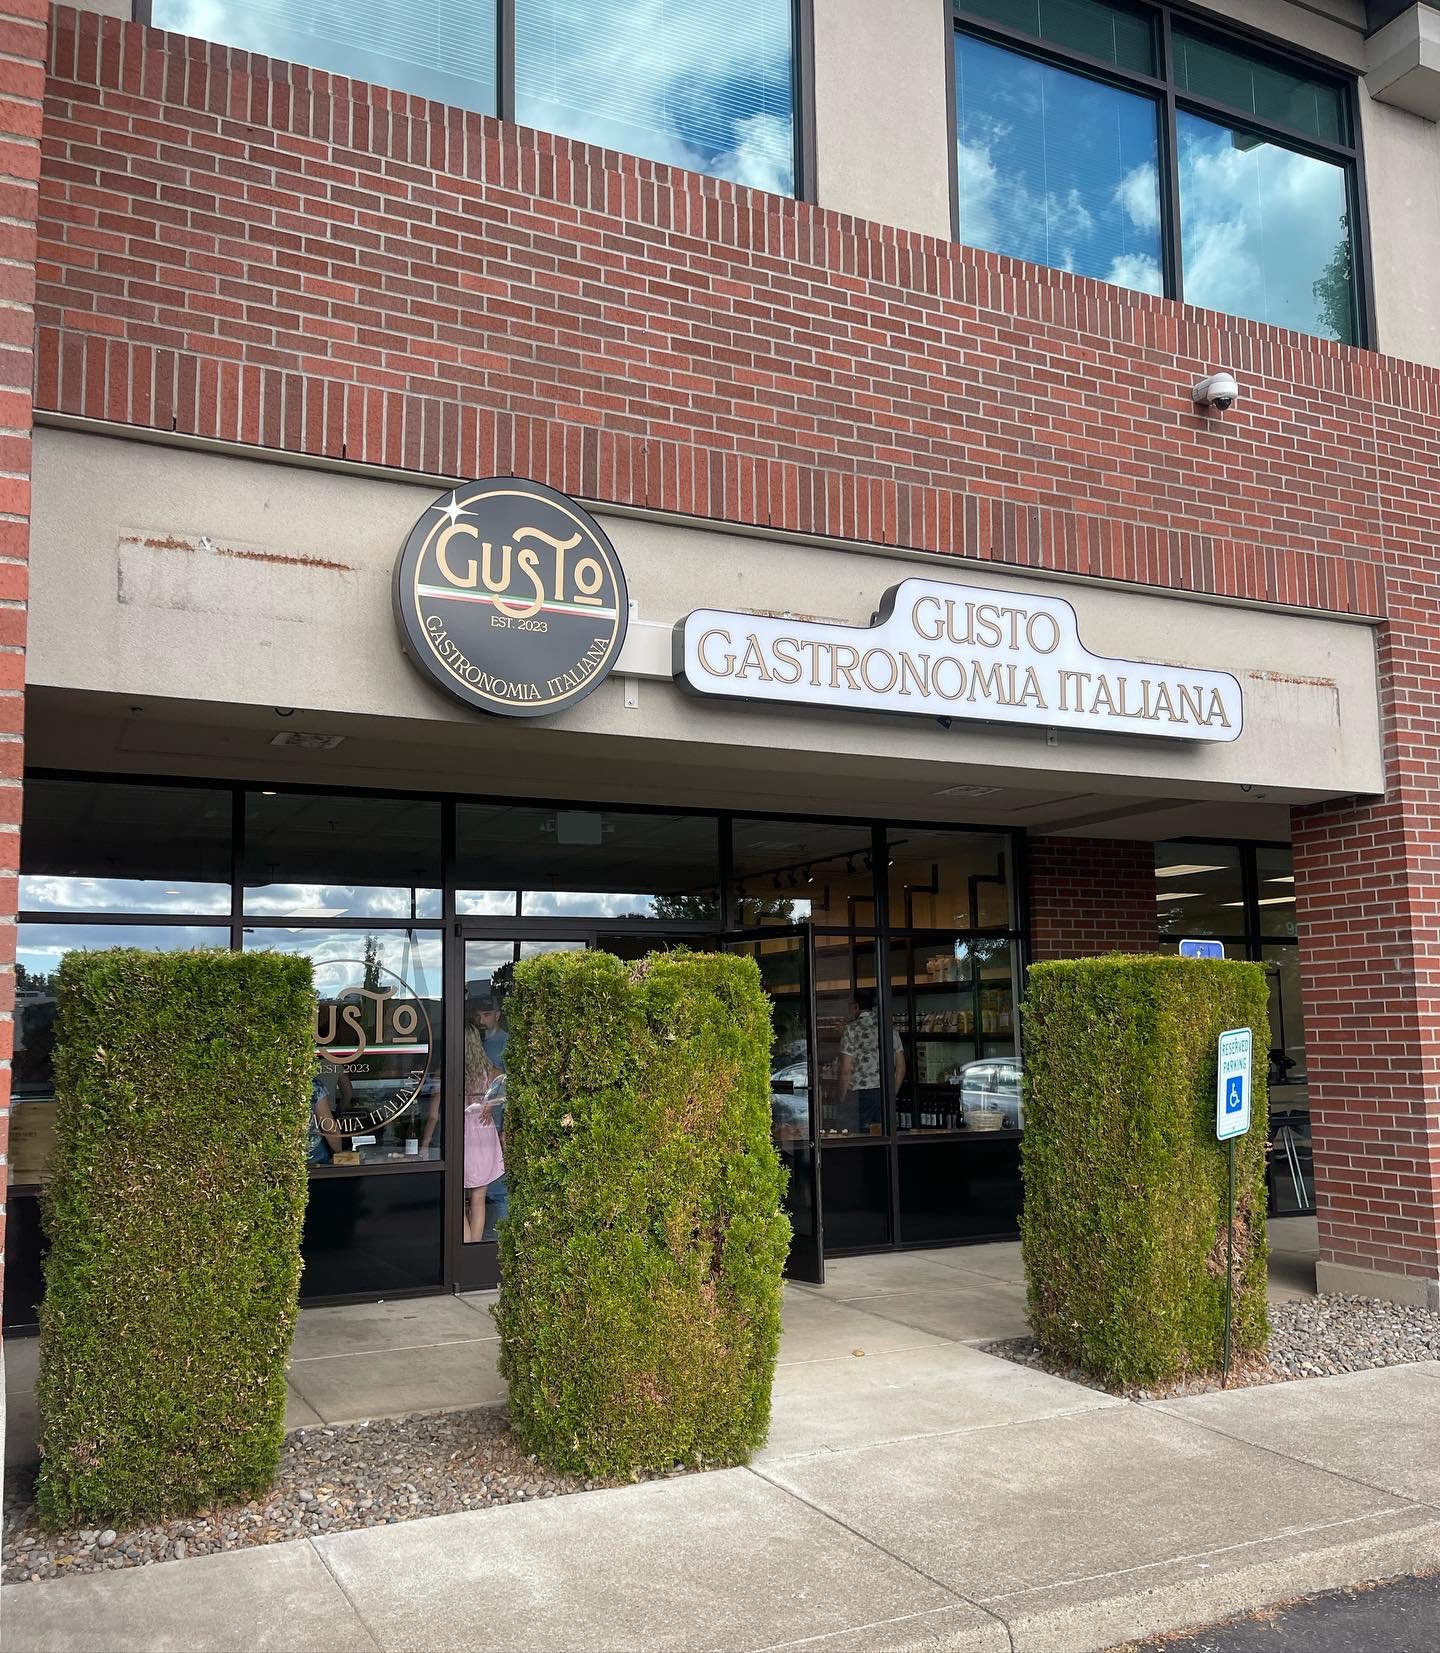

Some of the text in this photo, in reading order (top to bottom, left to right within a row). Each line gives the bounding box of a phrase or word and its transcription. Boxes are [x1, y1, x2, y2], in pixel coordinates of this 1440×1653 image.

[435, 523, 603, 619] GUSTO
[517, 619, 549, 633] 2023
[912, 596, 1060, 655] GUSTO
[426, 614, 610, 700] GASTRONOMIA ITALIANA
[697, 629, 1232, 728] GASTRONOMIA ITALIANA
[312, 985, 419, 1065] USTO
[1221, 1040, 1249, 1057] RESERVED
[343, 1063, 370, 1074] 2023
[1223, 1058, 1247, 1074] PARKING
[369, 1069, 424, 1125] ITALIANA
